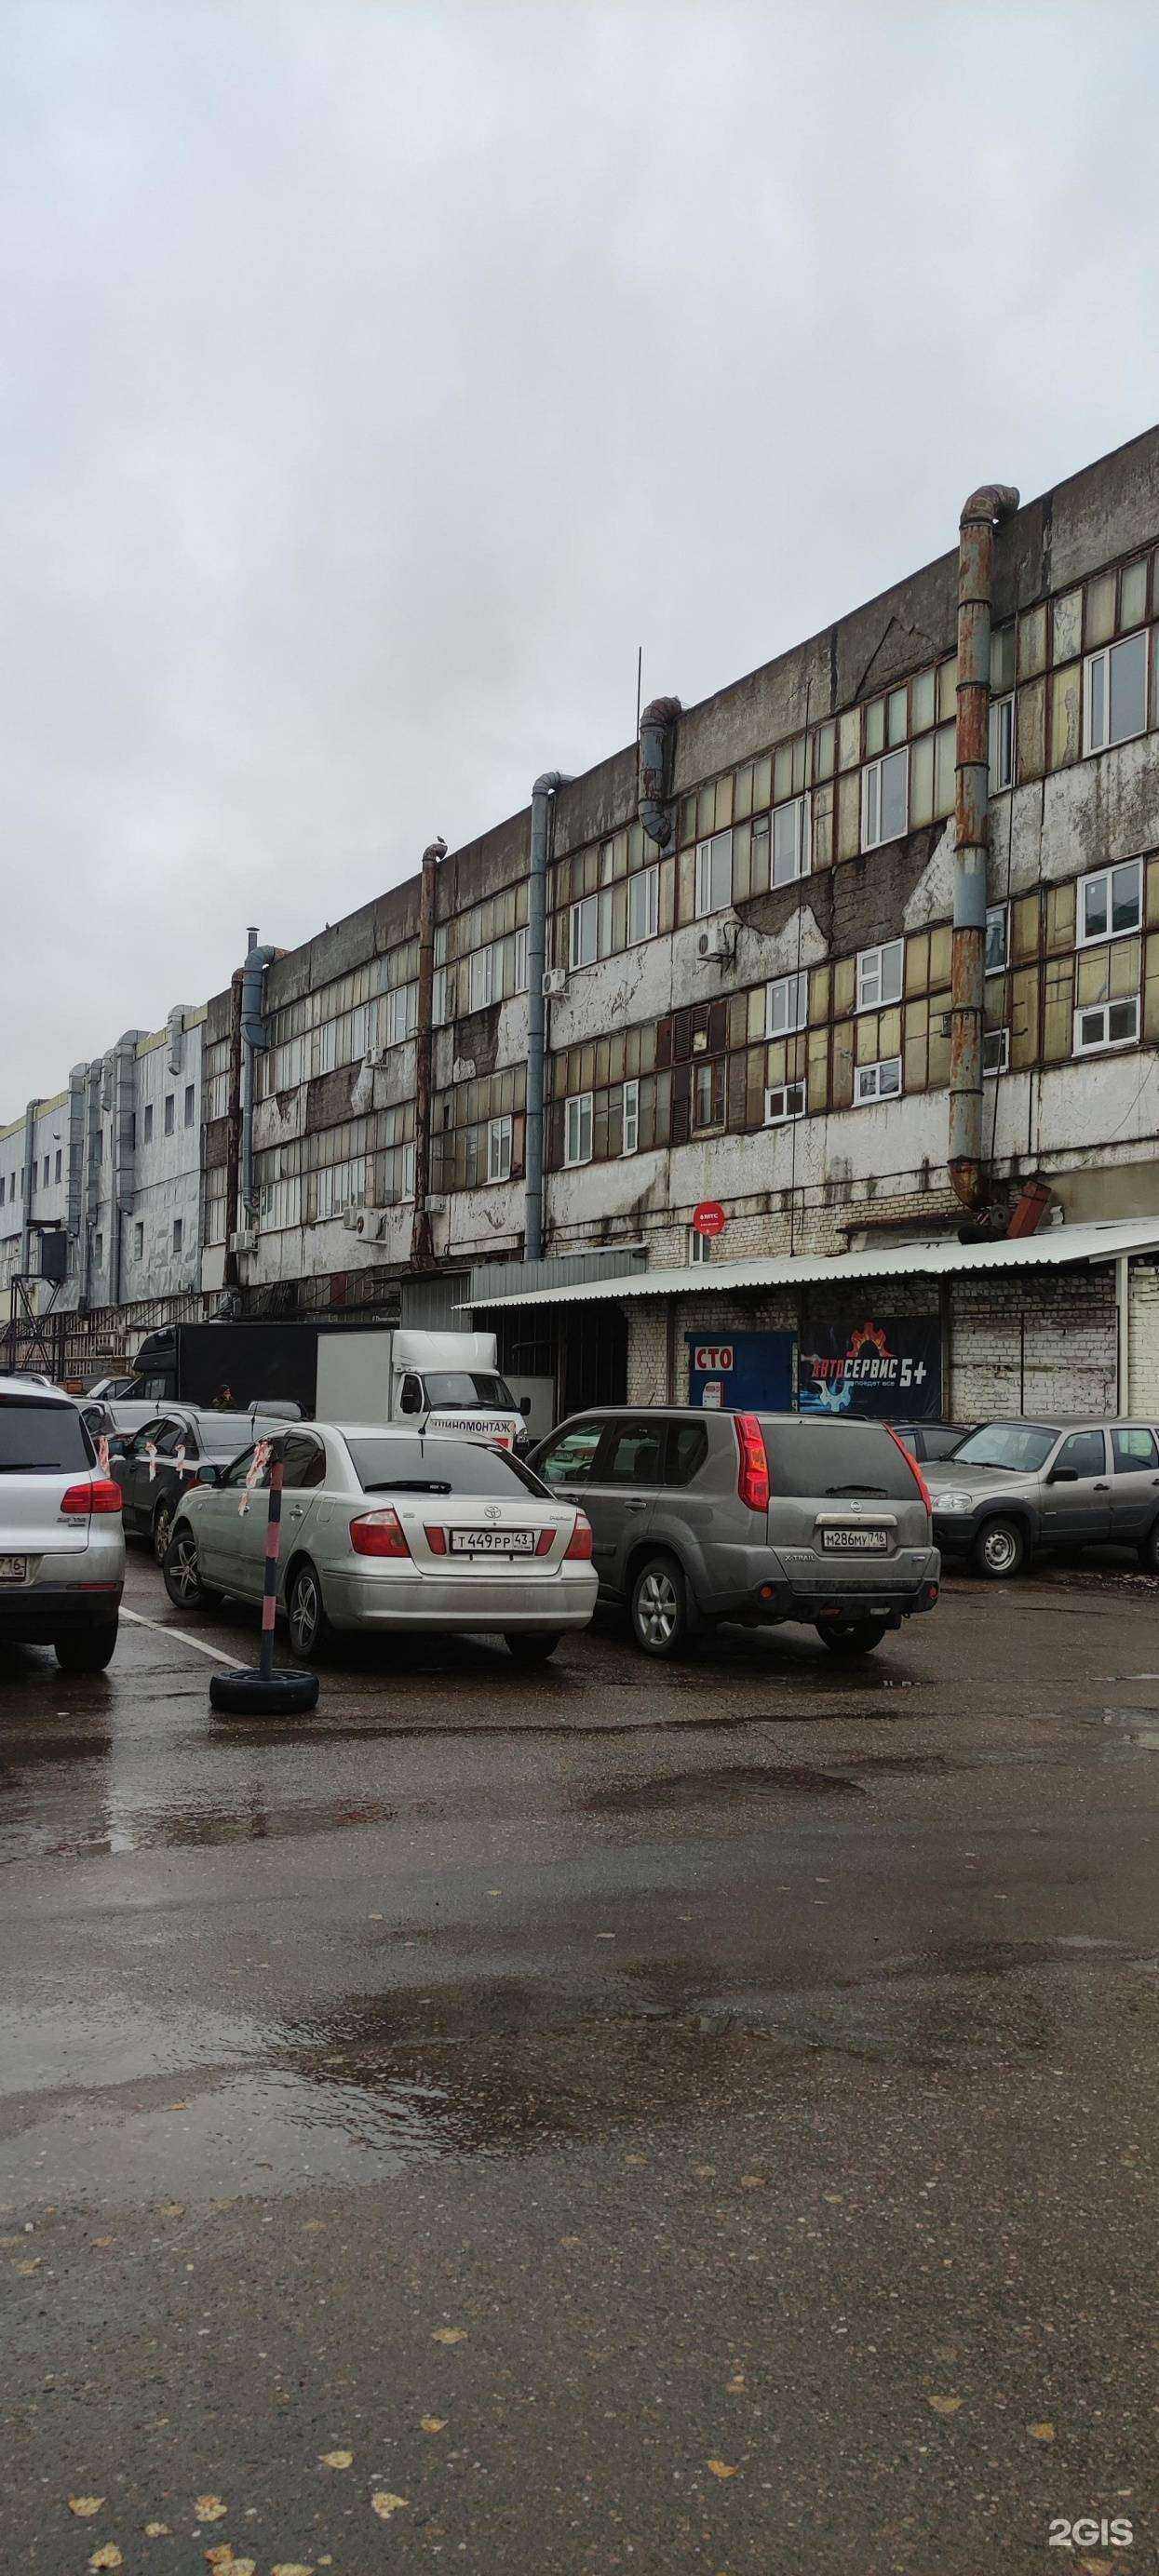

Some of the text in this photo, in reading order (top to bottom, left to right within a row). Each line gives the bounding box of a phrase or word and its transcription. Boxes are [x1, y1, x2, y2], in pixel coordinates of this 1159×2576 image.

[696, 1348, 733, 1369] СТО
[812, 1359, 927, 1387] АВТОСЕРВИС 5+
[458, 1534, 528, 1549] Т449РР 43
